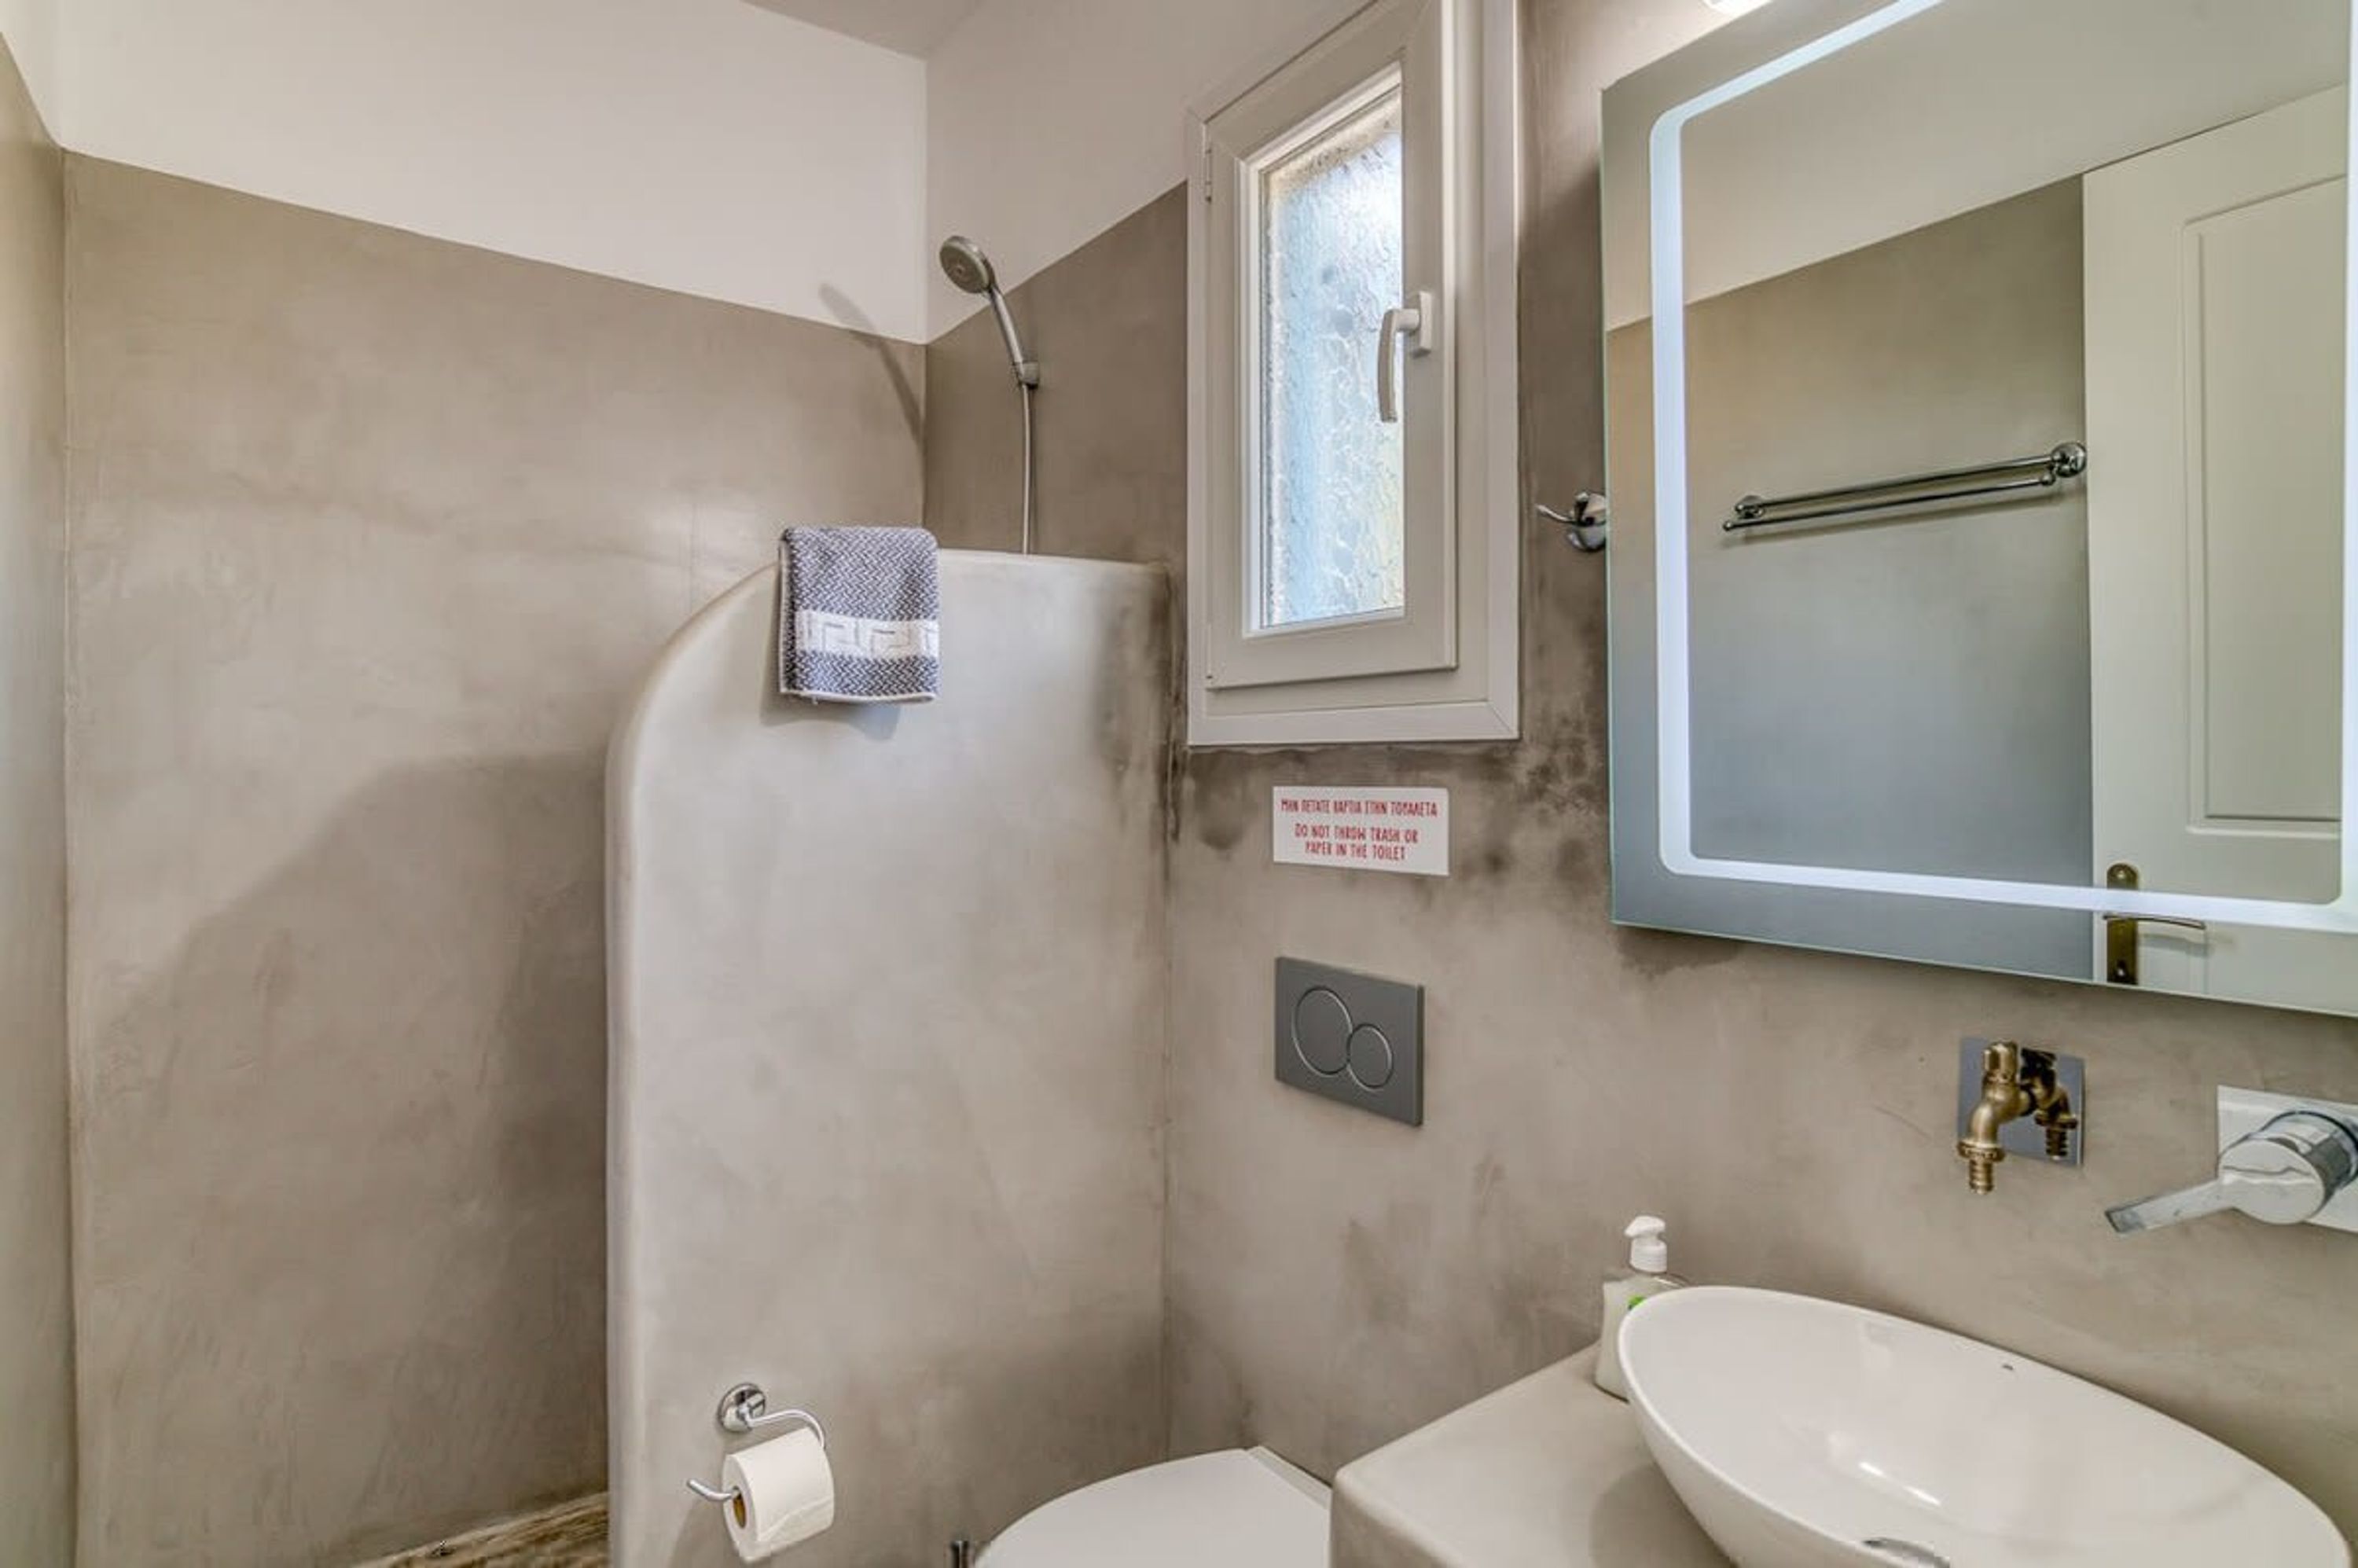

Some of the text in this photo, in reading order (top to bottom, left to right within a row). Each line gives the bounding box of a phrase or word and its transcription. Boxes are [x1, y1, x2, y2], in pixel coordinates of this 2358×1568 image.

[1295, 823, 1418, 843] DO NOT THROW TRASH OR
[1305, 841, 1405, 861] PAPER IN THE TOILET
